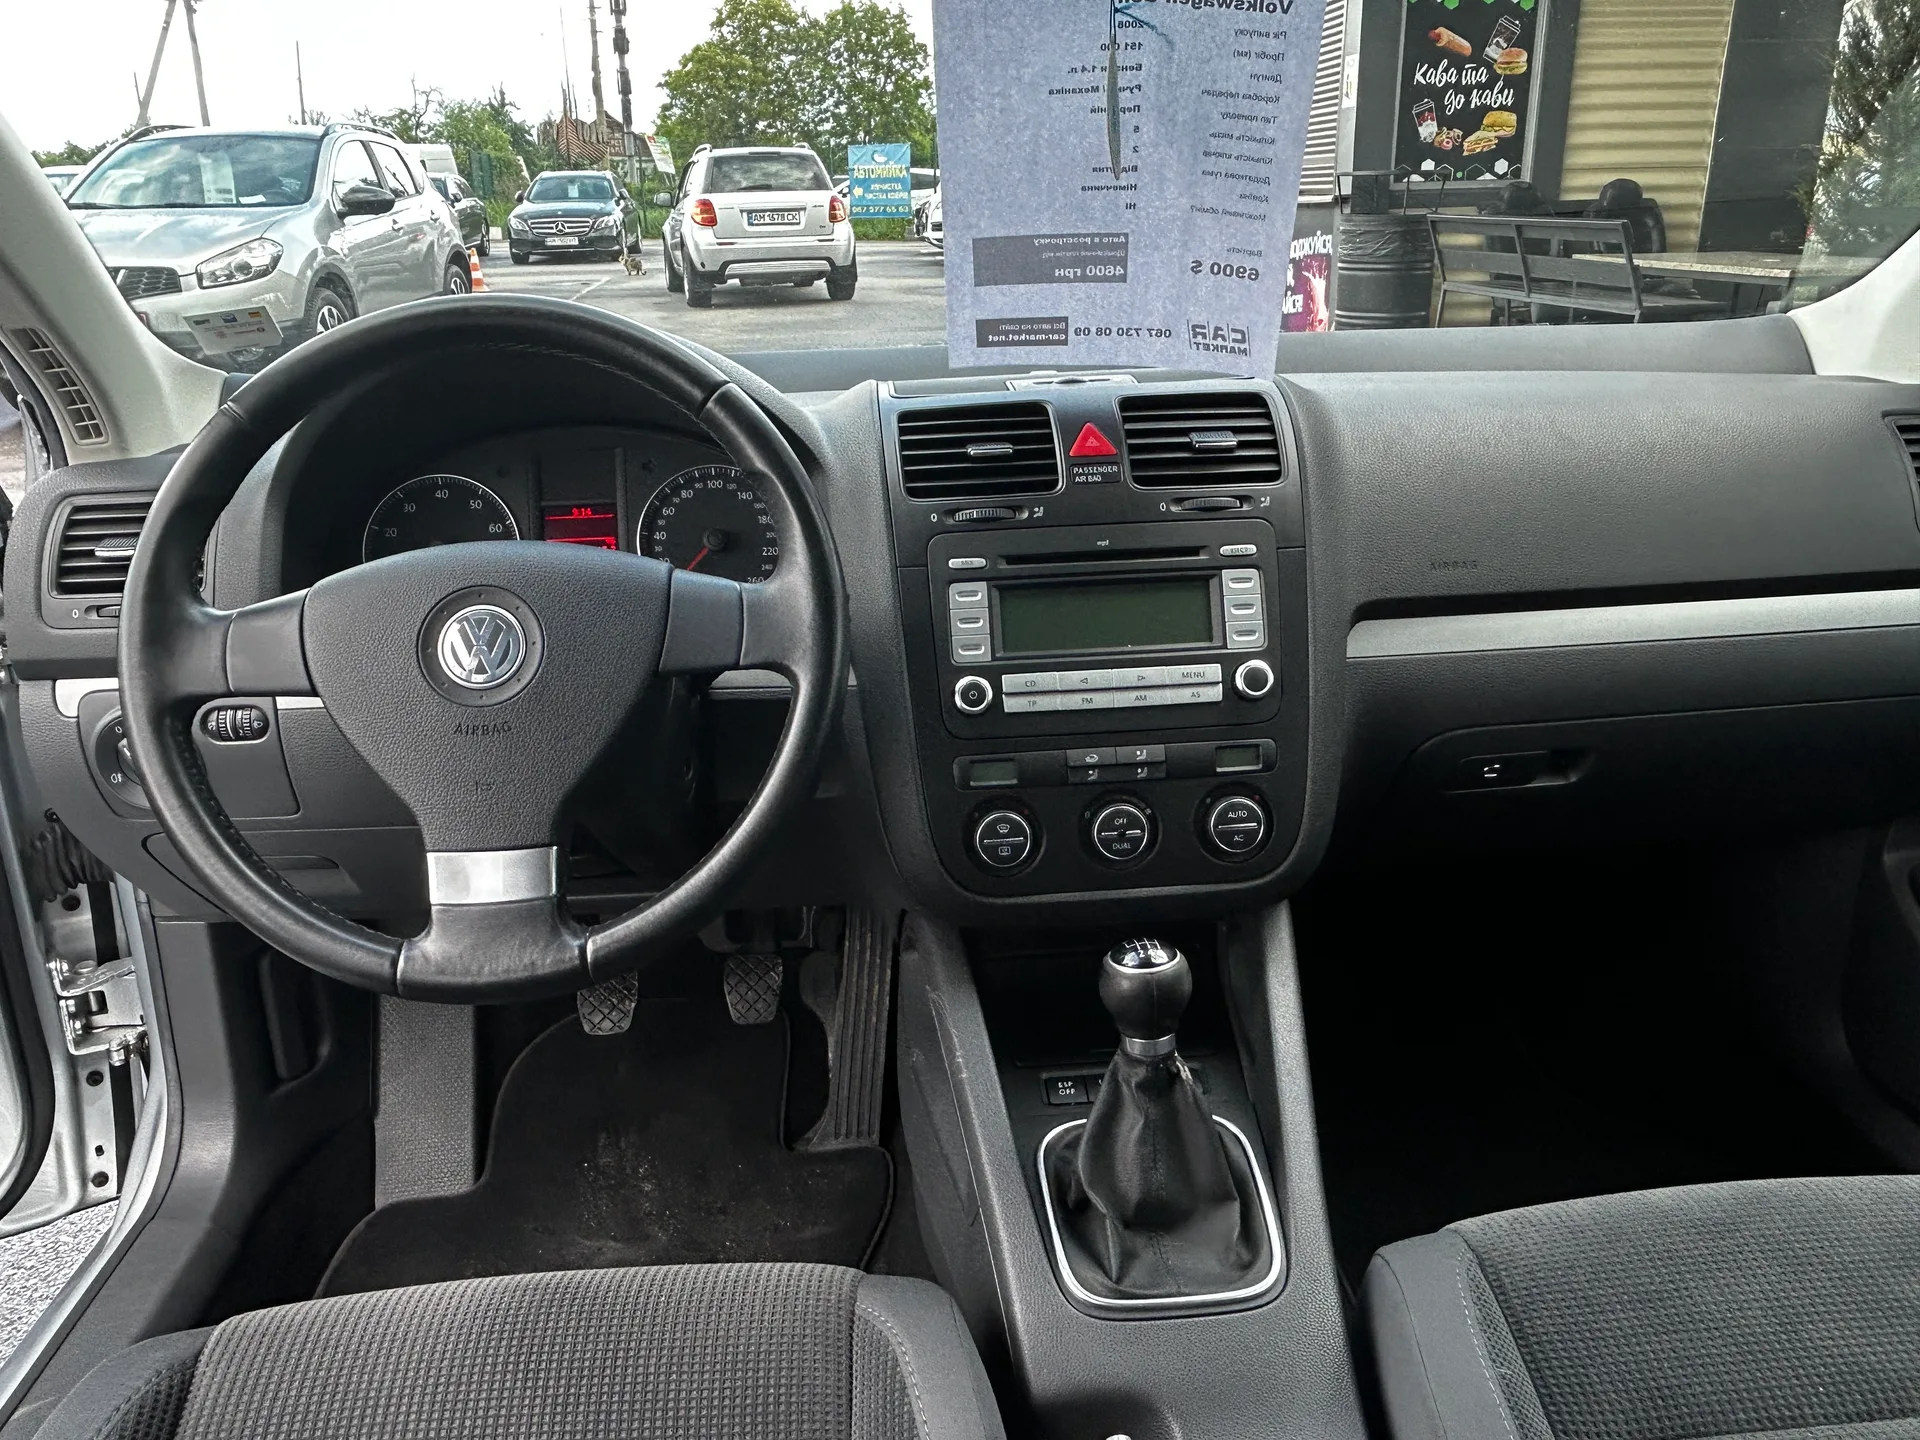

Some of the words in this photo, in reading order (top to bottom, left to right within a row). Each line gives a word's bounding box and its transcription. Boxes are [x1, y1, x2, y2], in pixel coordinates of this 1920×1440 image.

[1413, 58, 1459, 88] Кава
[1461, 63, 1490, 85] та
[1444, 88, 1466, 115] до
[1469, 75, 1515, 108] кави
[1073, 465, 1118, 474] PASSENGER
[707, 480, 723, 489] 100
[435, 489, 449, 499] 40
[680, 489, 694, 499] 80
[737, 491, 753, 500] 140
[403, 502, 416, 513] 30
[469, 499, 483, 509] 50
[662, 506, 675, 516] 60
[384, 527, 398, 537] 20
[488, 523, 503, 533] 60
[653, 531, 667, 540] 40
[762, 547, 779, 556] 220
[1181, 671, 1206, 680] MENU
[1024, 680, 1036, 688] CD
[1133, 695, 1149, 703] AM
[1190, 691, 1201, 699] AS
[1081, 697, 1094, 705] FM
[453, 720, 512, 737] AIRBAG
[1227, 809, 1248, 819] AUTO
[1113, 817, 1128, 826] OFF
[1233, 834, 1245, 843] AC
[1112, 841, 1132, 851] DUAL
